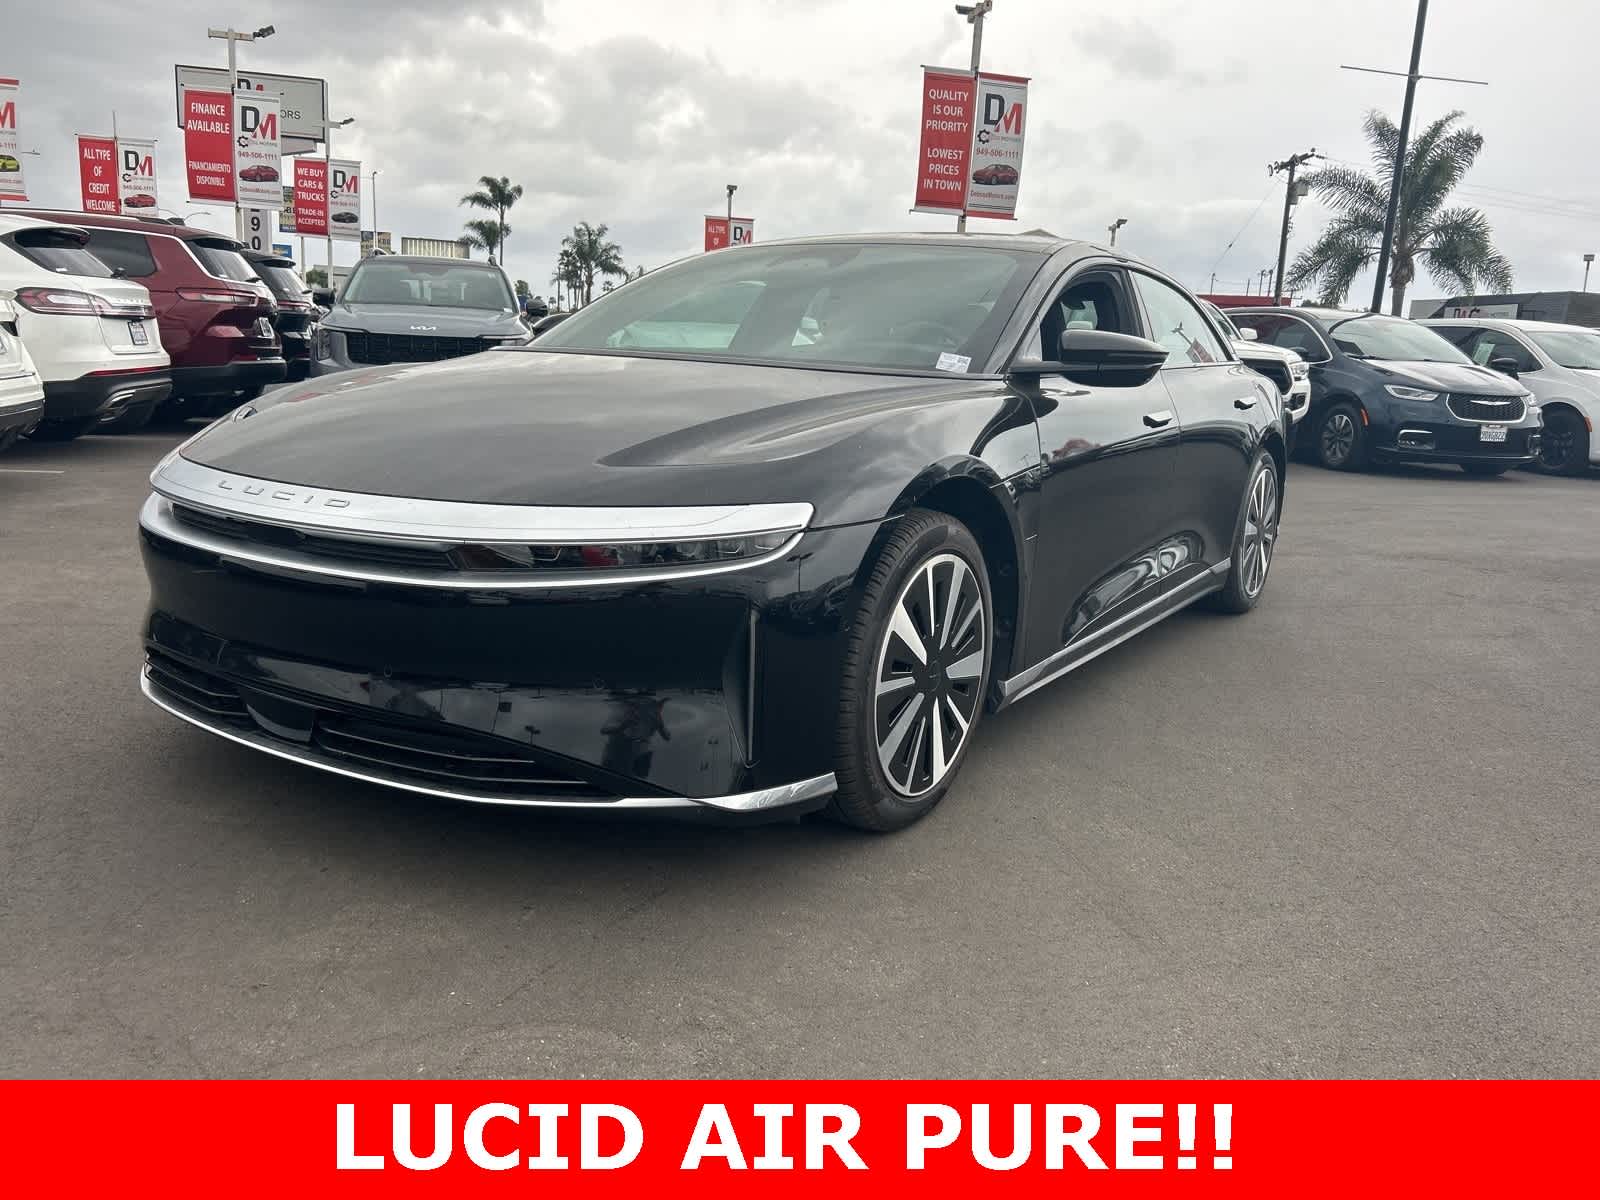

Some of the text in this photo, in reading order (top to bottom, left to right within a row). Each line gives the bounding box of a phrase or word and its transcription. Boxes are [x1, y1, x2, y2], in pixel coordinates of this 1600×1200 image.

[928, 89, 969, 101] QUALITY
[191, 102, 225, 117] FINANCE
[280, 109, 302, 120] ORS
[933, 104, 963, 117] IS OUR
[187, 120, 230, 134] AVAILABLE
[926, 120, 969, 133] PRIORITY
[83, 148, 111, 161] ALL TYPE
[927, 147, 964, 161] LOWEST
[93, 165, 103, 177] OF
[297, 167, 325, 178] WE BUY
[928, 163, 960, 176] PRICES
[196, 175, 226, 187] DISPONIBLE
[298, 179, 324, 190] CARS &
[923, 179, 962, 191] IN TOWN
[88, 182, 110, 195] CREDIT
[297, 192, 325, 202] TRUCKS
[85, 199, 116, 212] WELCOME
[298, 207, 324, 217] TRADE-IN
[297, 217, 326, 226] ACCEPTED
[217, 480, 351, 508] LUCID
